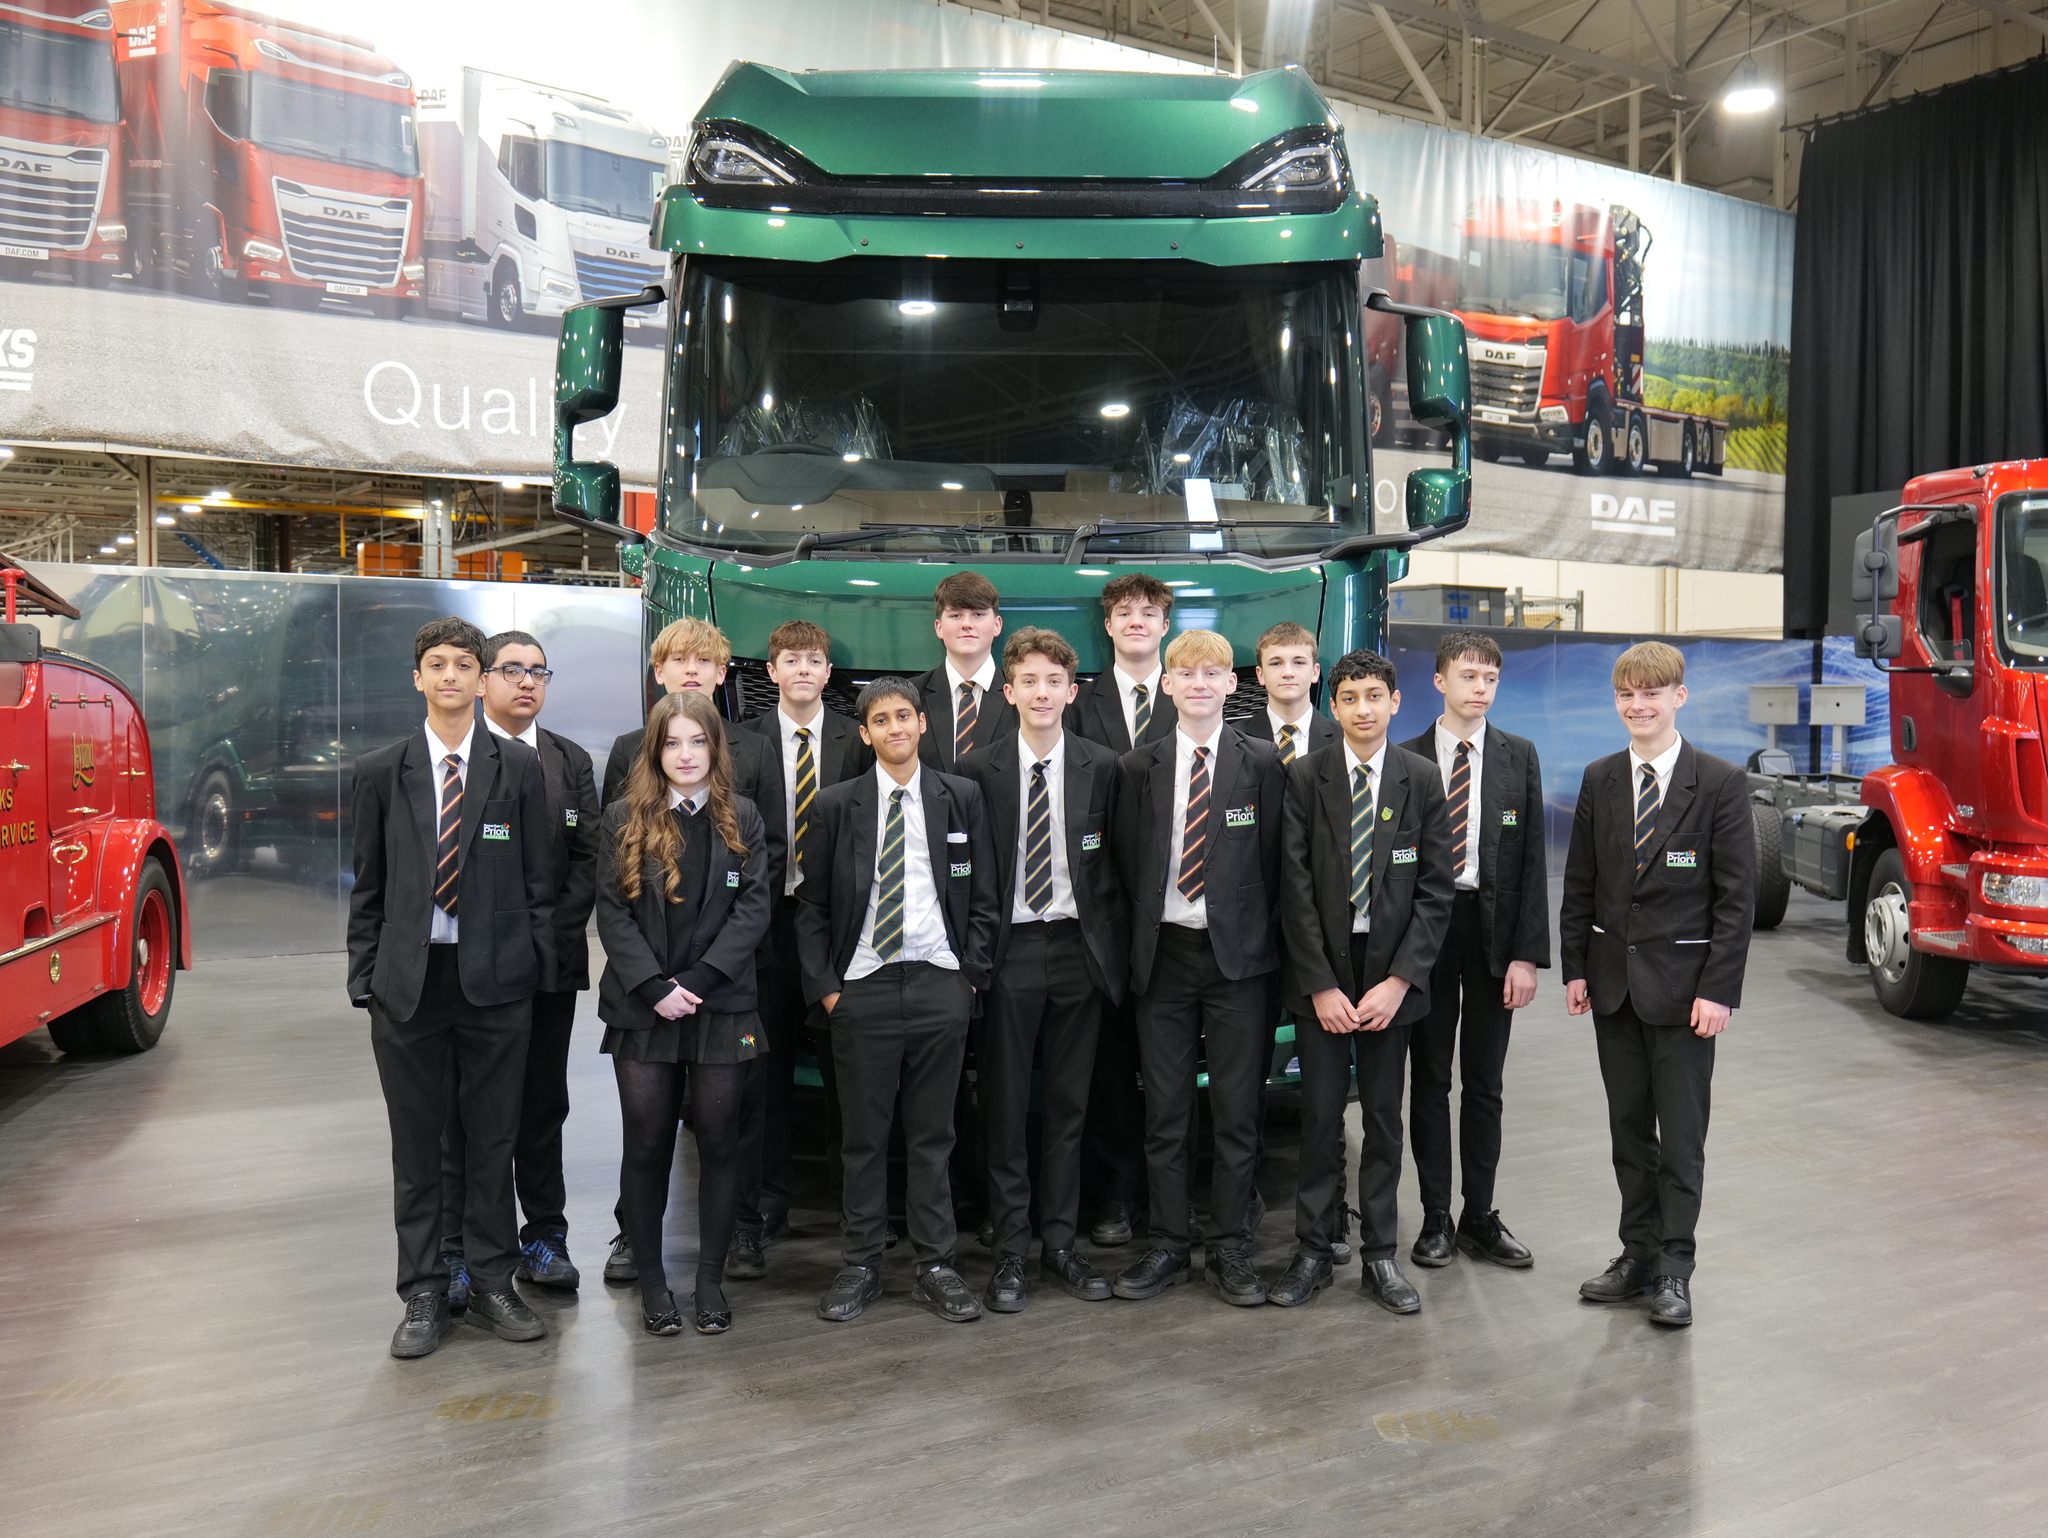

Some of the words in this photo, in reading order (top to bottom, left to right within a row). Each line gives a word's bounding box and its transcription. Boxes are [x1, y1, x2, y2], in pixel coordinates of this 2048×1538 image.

[128, 25, 156, 48] DAF
[421, 89, 446, 101] DAF
[323, 206, 371, 220] DAF
[5, 247, 40, 258] DAF.COM
[605, 247, 641, 259] DAF
[334, 284, 361, 294] DAF.COM
[1485, 349, 1516, 360] DAF
[1590, 493, 1676, 523] DAF
[1226, 811, 1255, 823] Priory
[483, 826, 510, 838] Priory
[1393, 851, 1416, 861] Priory
[1666, 854, 1696, 865] Priory
